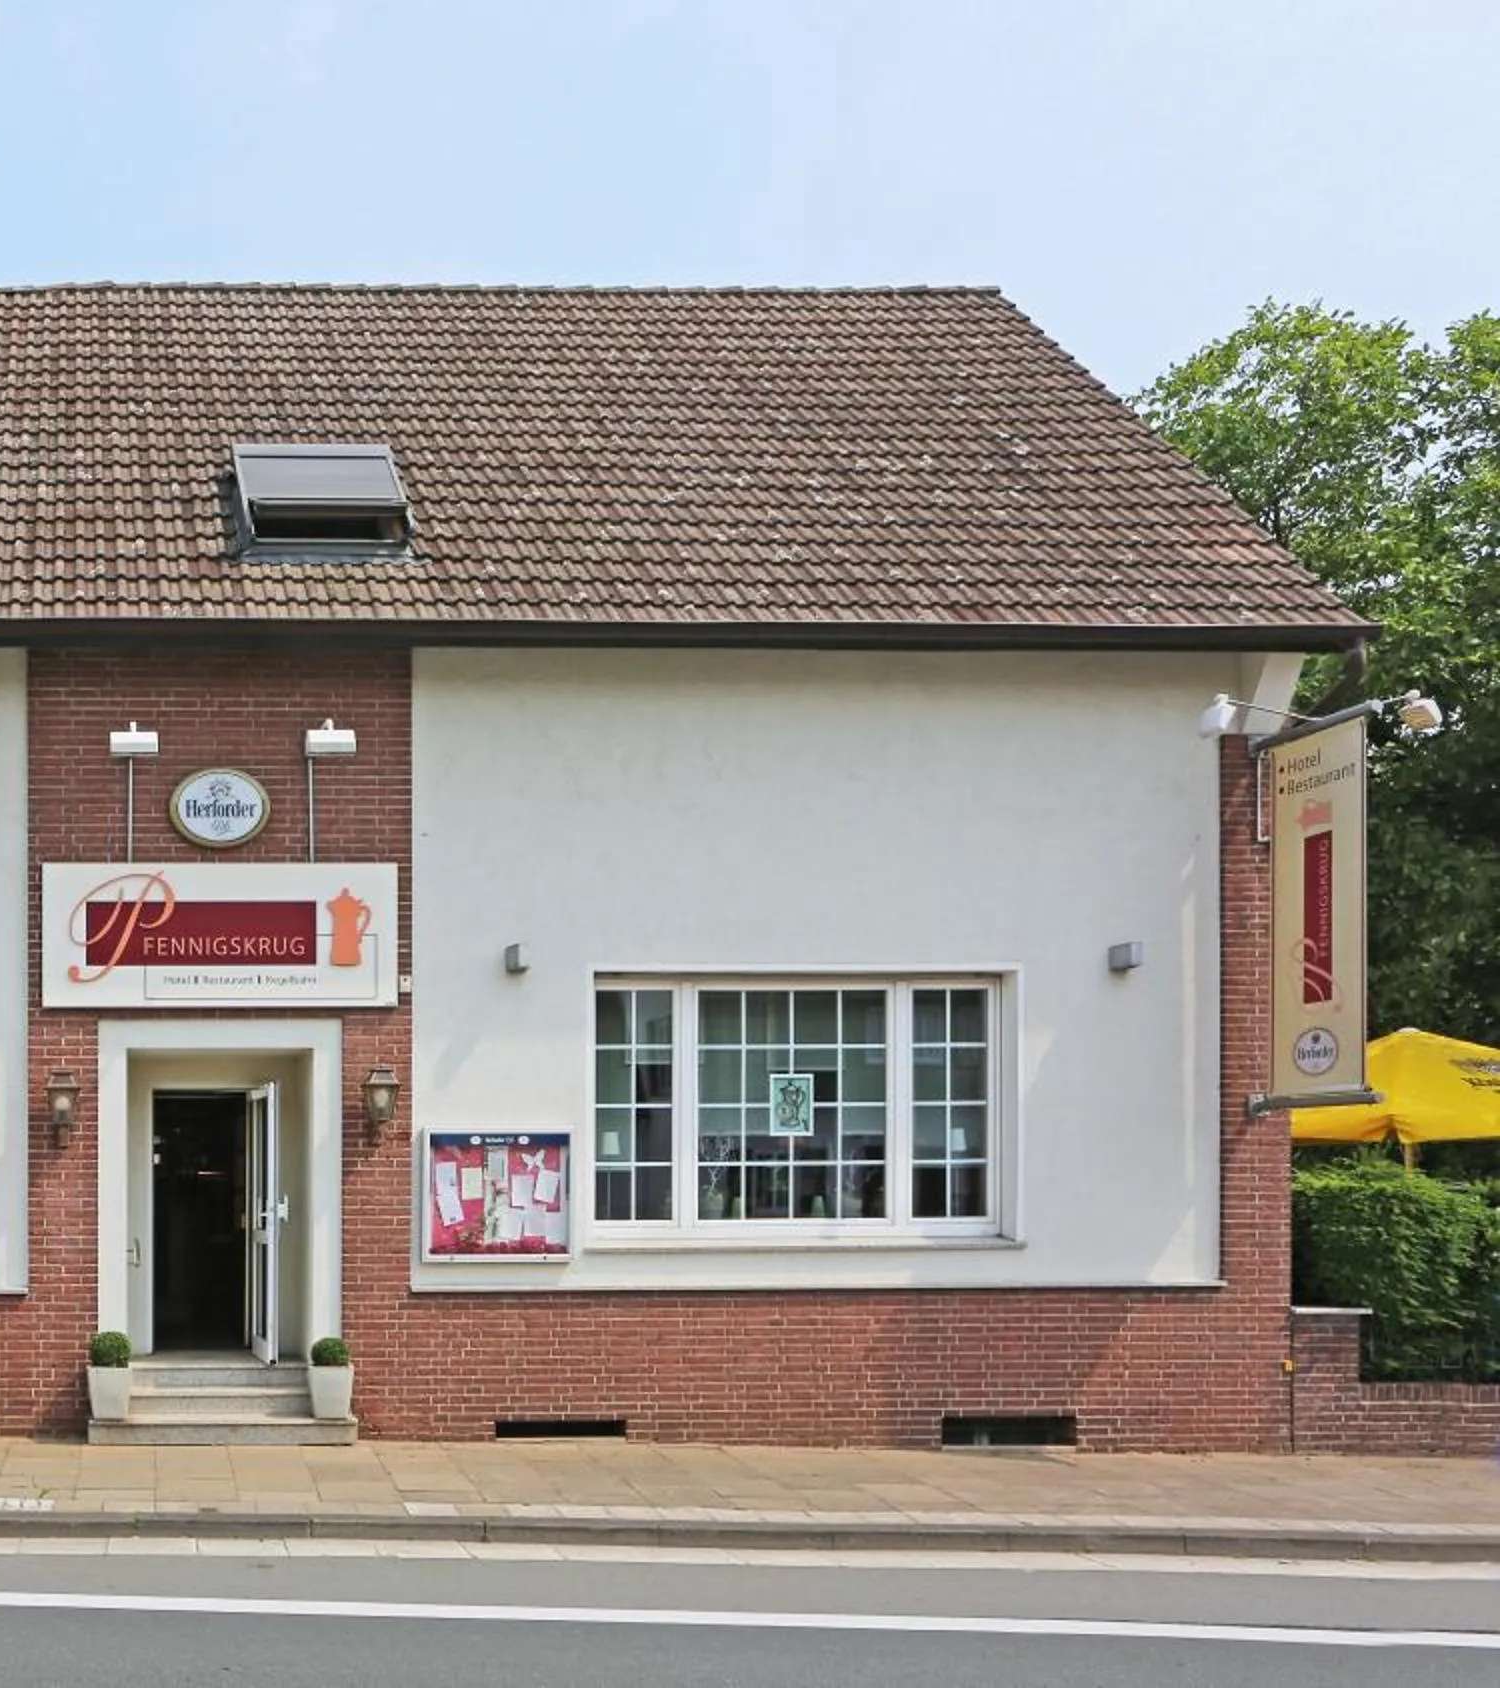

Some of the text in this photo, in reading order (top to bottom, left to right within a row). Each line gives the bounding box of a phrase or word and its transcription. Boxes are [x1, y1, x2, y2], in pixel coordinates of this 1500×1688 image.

[1286, 748, 1322, 775] Hotel
[1286, 763, 1356, 796] Restaurant
[185, 799, 257, 818] Herforder
